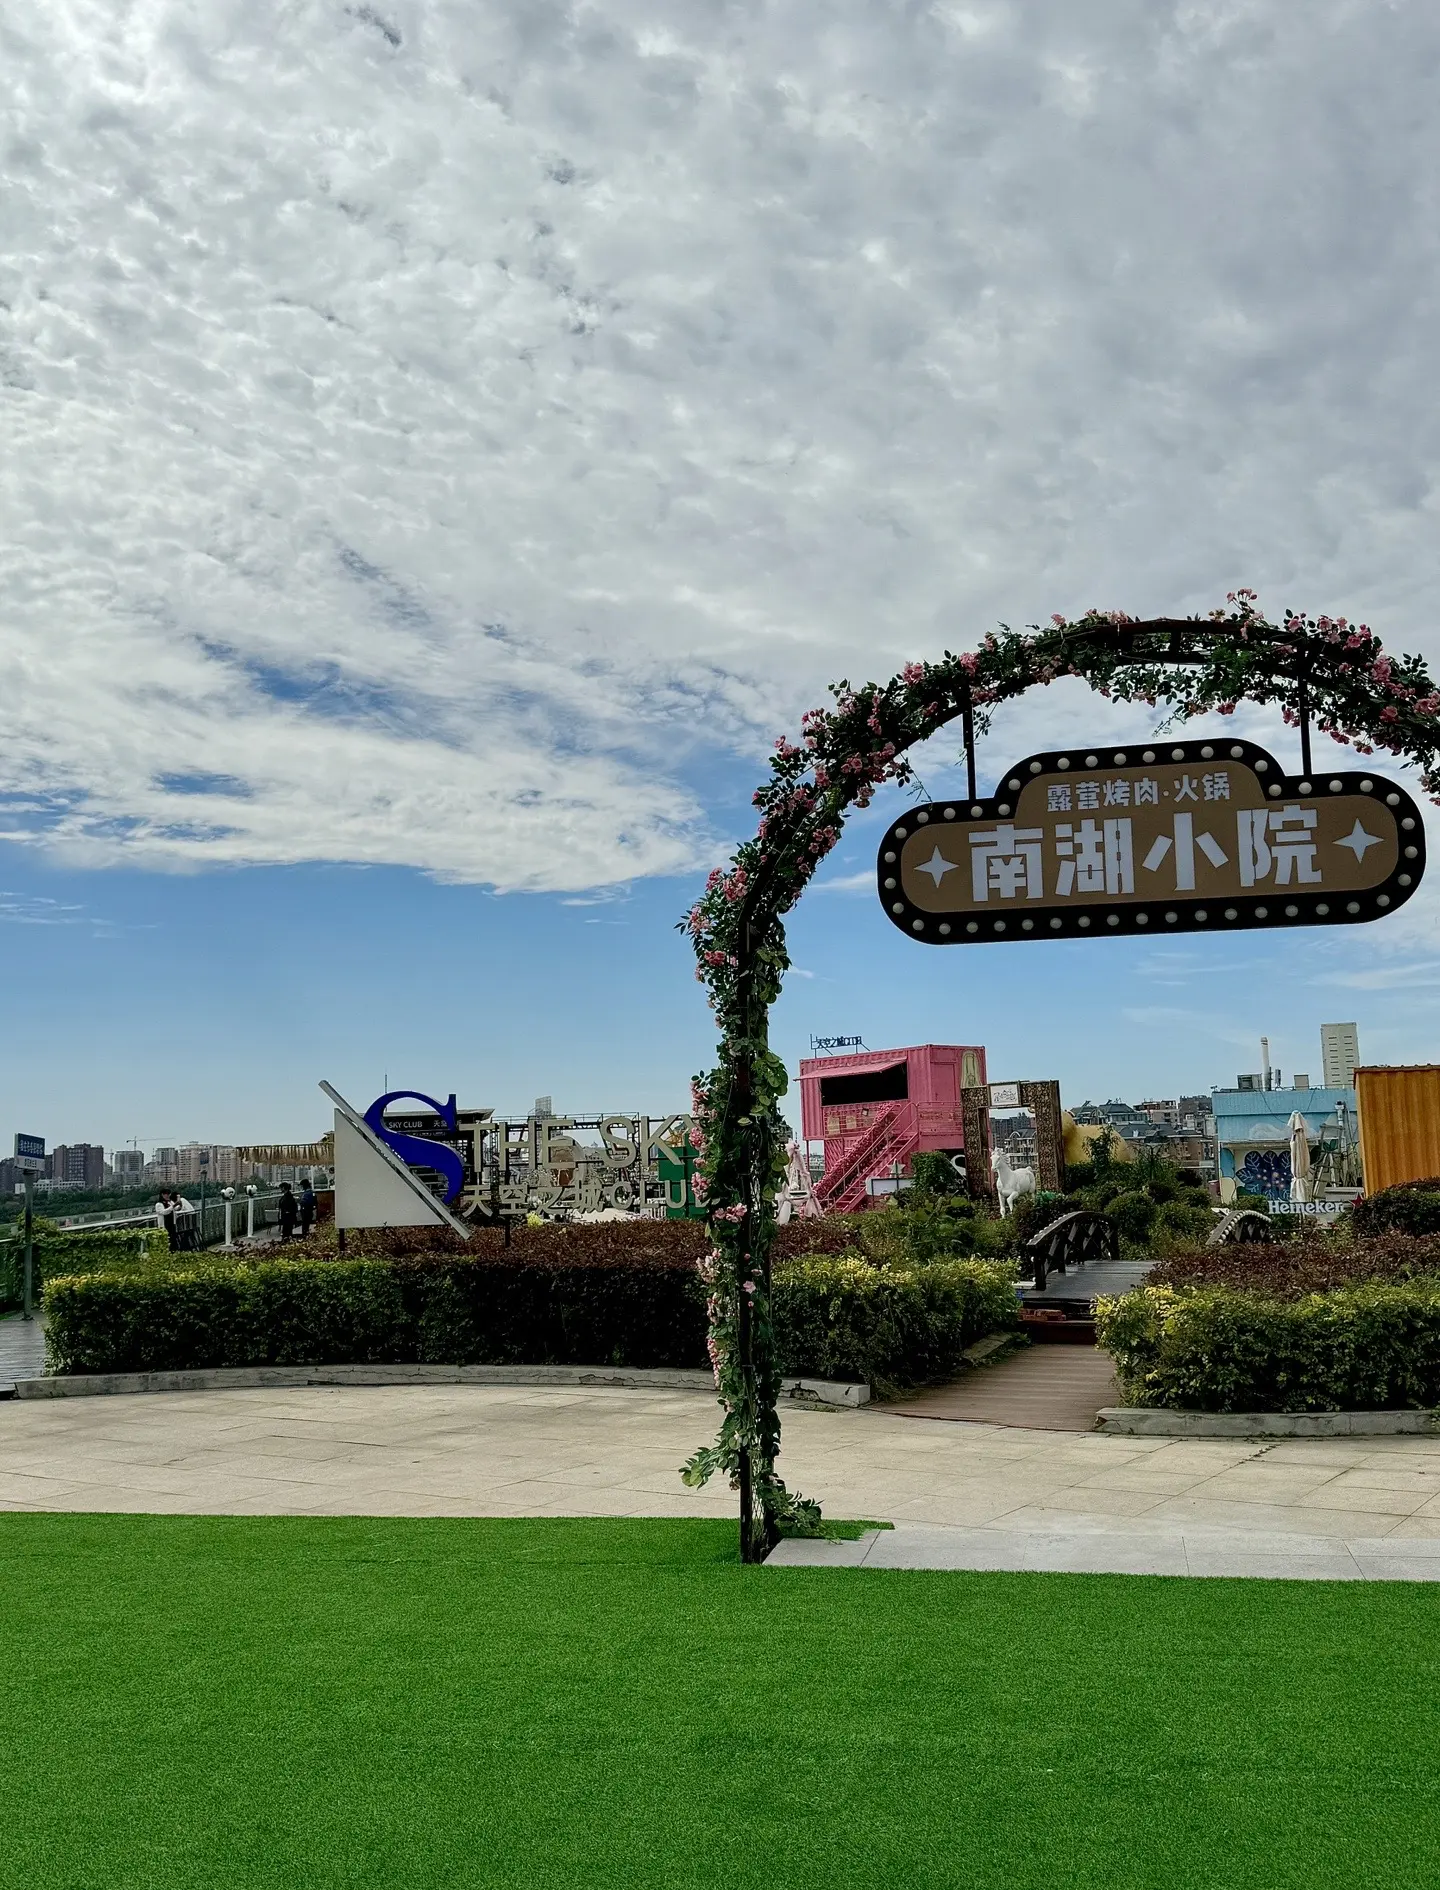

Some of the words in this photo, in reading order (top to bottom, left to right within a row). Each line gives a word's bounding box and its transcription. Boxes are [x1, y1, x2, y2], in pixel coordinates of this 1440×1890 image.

[1047, 771, 1231, 812] 露营烤肉·火锅
[968, 804, 1322, 903] 南湖小院
[388, 1121, 401, 1129] SKY
[403, 1120, 423, 1128] CLUB
[459, 1119, 575, 1173] THE
[609, 1179, 708, 1209] CLU
